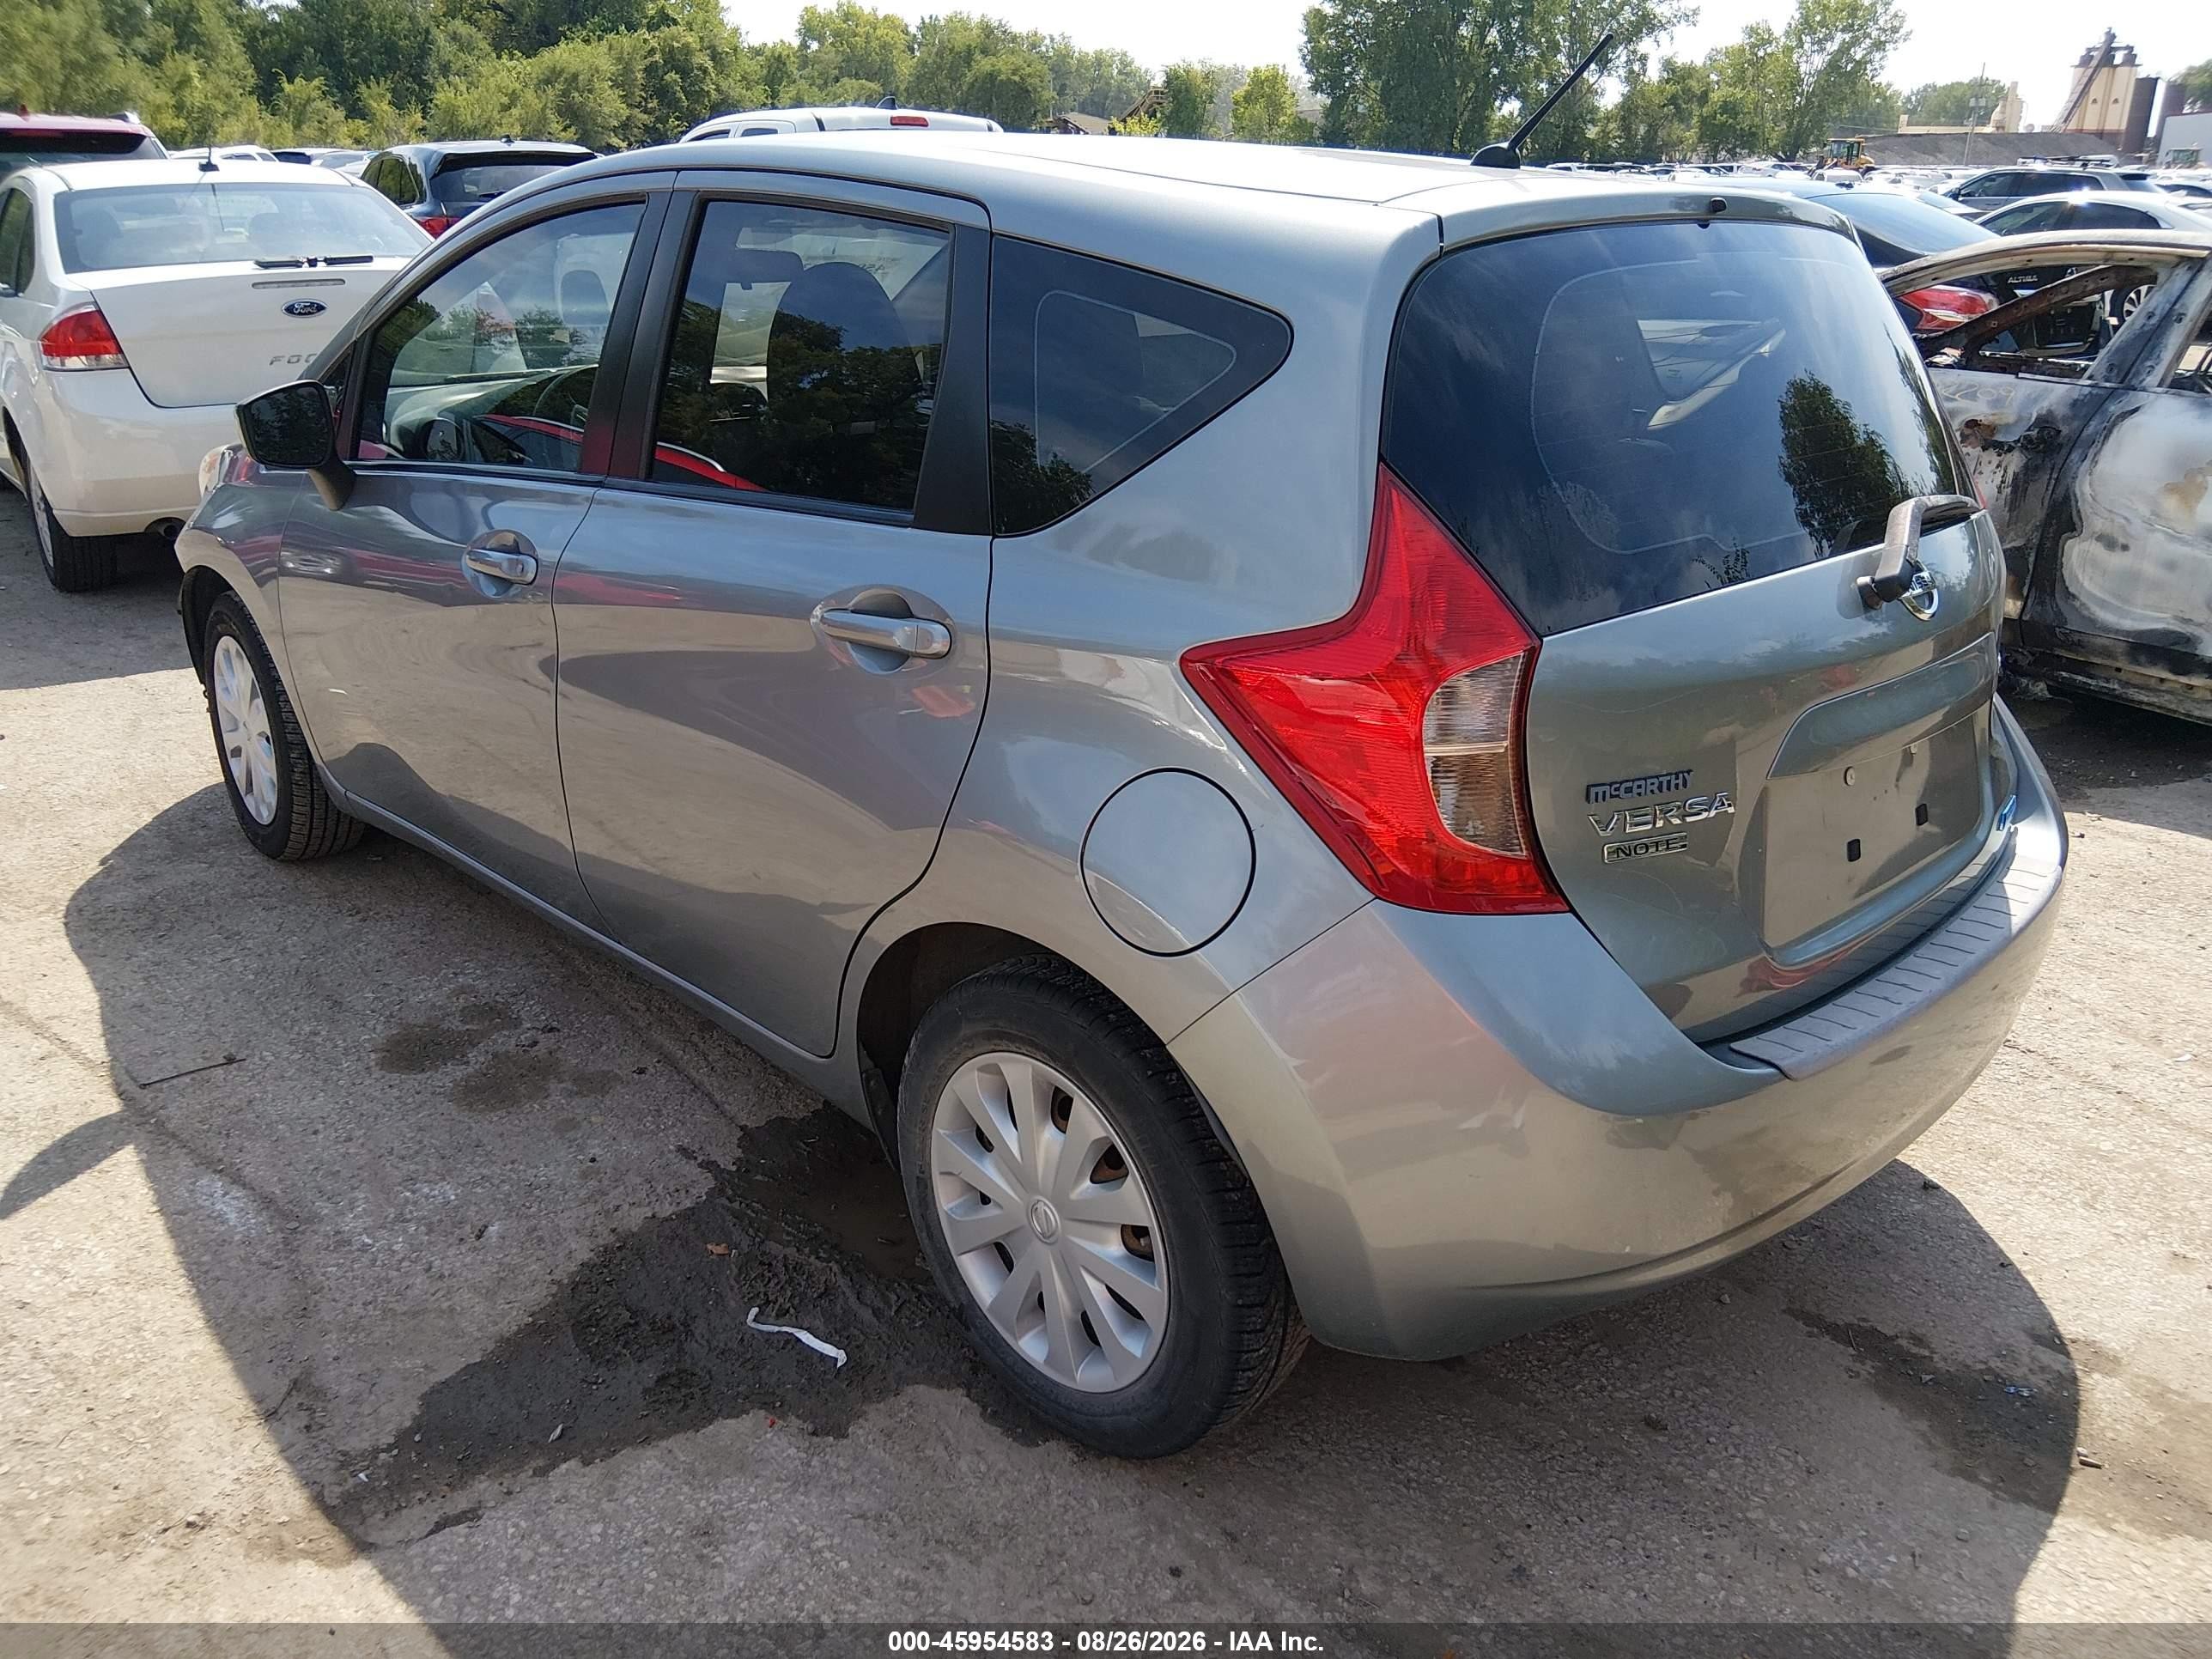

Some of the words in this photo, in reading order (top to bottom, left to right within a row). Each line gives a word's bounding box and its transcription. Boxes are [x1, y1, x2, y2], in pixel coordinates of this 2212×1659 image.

[269, 353, 318, 366] FOC
[1588, 792, 1735, 837] VERSA
[1615, 837, 1679, 859] NOTE
